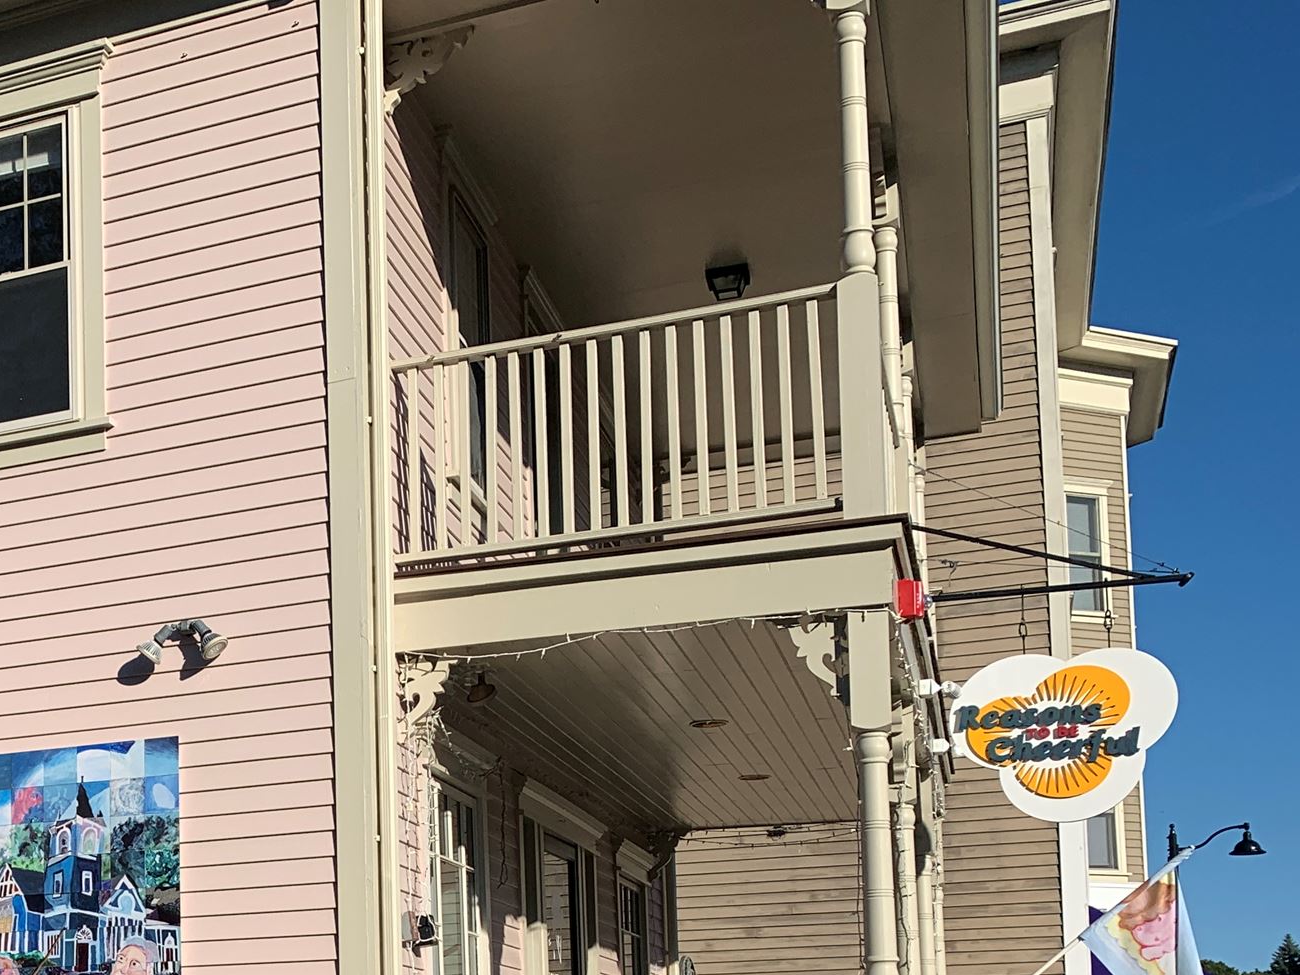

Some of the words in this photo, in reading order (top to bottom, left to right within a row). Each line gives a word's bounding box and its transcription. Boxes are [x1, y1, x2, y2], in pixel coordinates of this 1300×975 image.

[953, 703, 1102, 733] Reasons
[1025, 725, 1050, 741] TO
[1053, 724, 1080, 740] BE
[985, 726, 1142, 764] Cheerful
